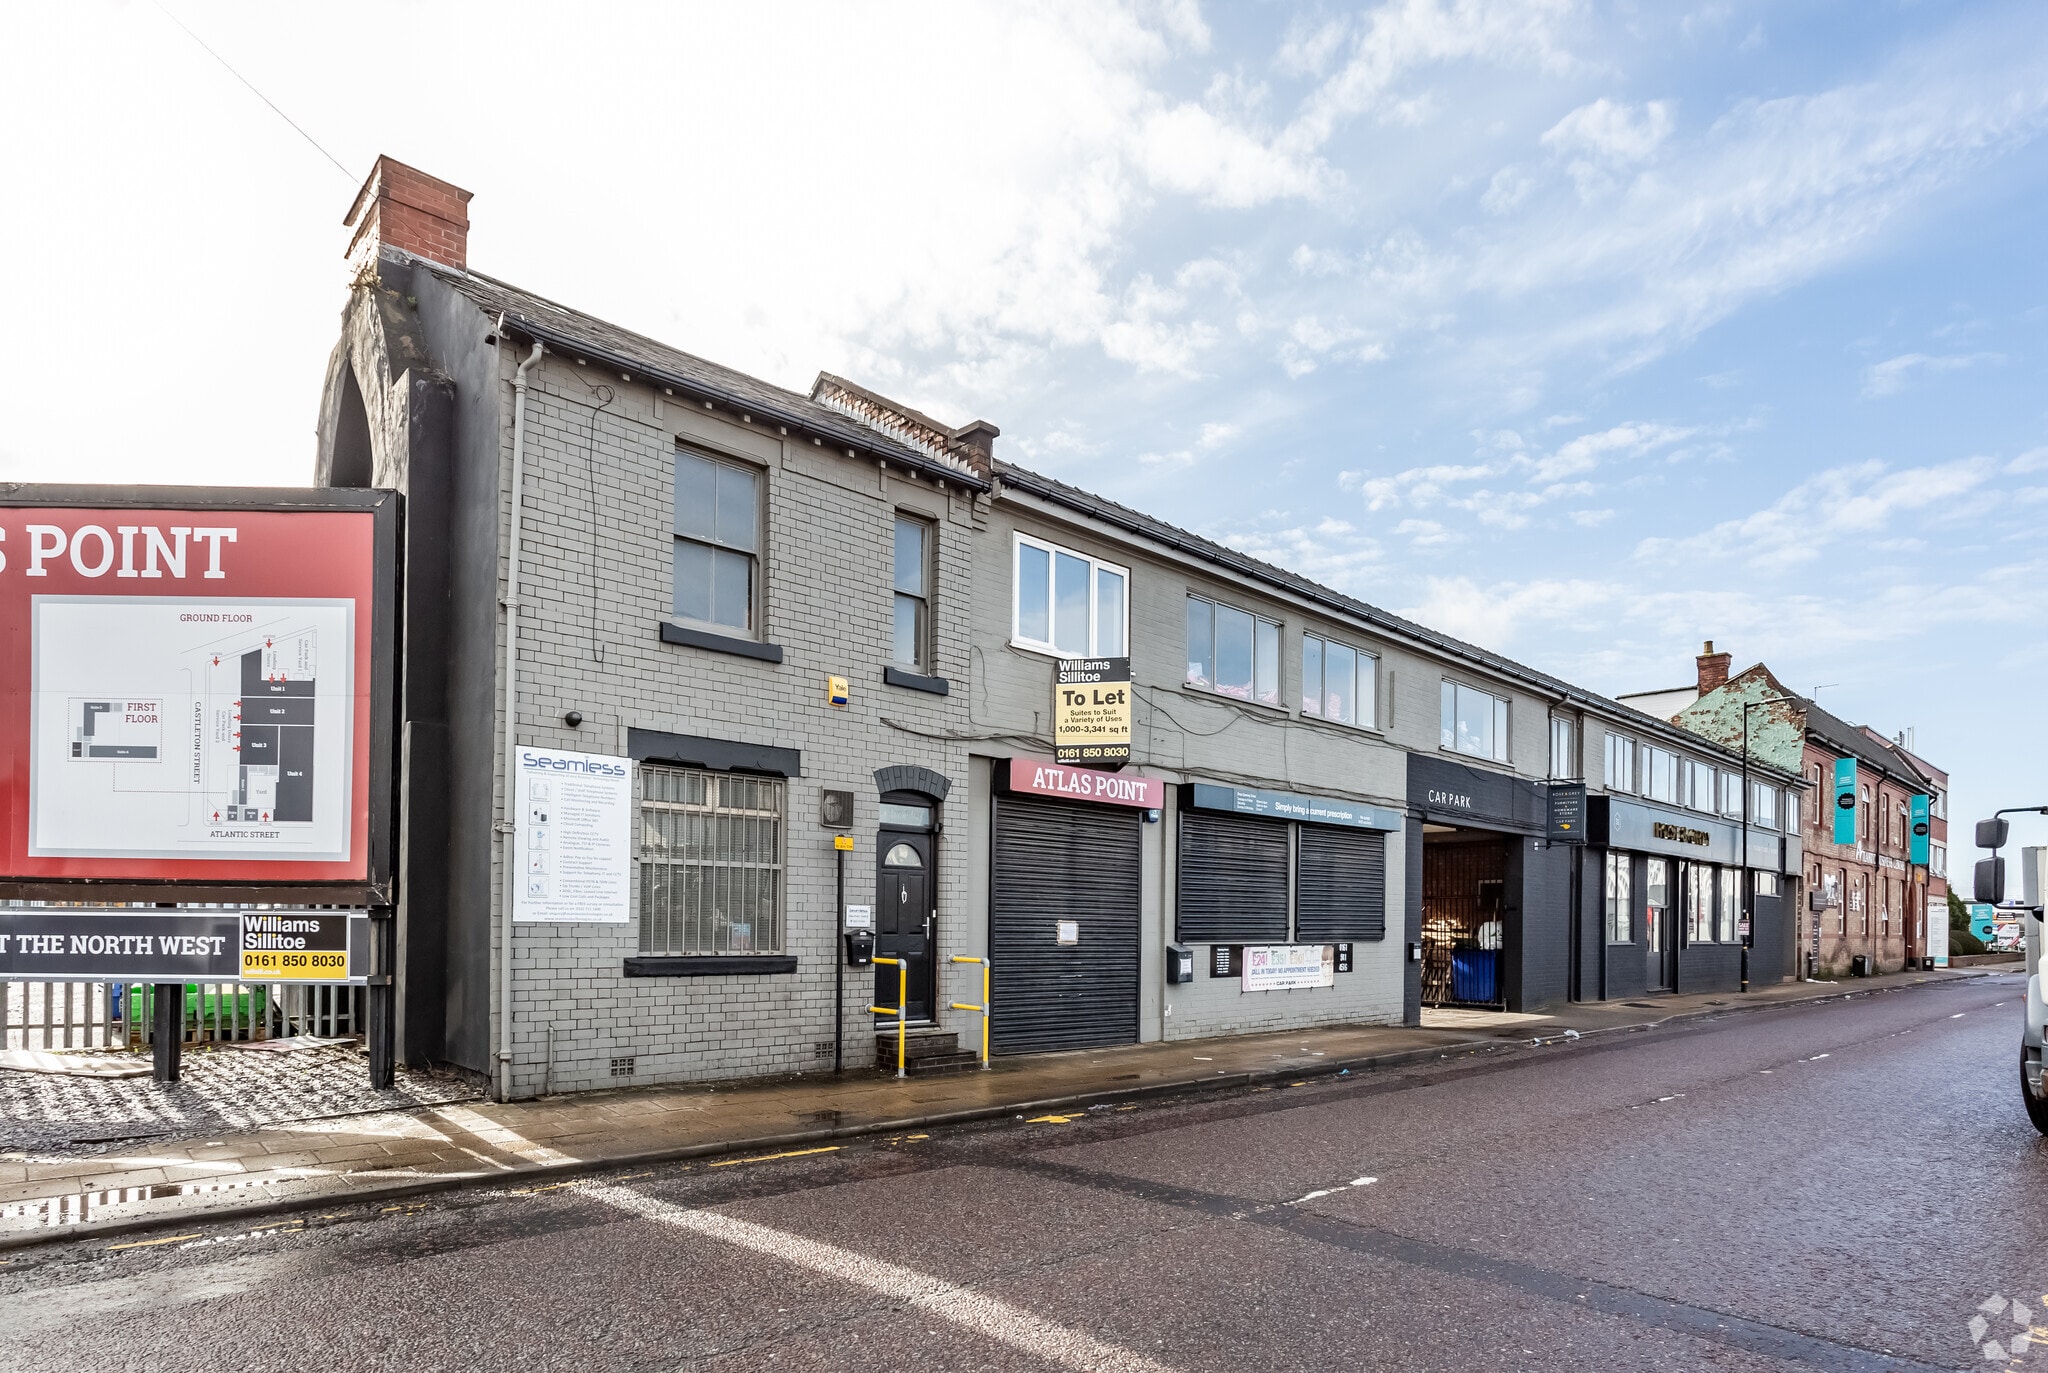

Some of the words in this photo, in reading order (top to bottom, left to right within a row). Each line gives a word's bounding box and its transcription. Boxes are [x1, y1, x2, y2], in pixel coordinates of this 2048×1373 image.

[26, 524, 238, 579] POINT
[180, 613, 220, 622] GROUND
[222, 614, 253, 623] FLOOR
[1059, 660, 1111, 671] Williams
[1059, 671, 1101, 683] Sillitoe
[834, 683, 847, 692] Yale
[1062, 690, 1086, 706] To
[1093, 689, 1125, 705] Let
[127, 702, 157, 712] FIRST
[125, 714, 159, 724] FLOOR
[194, 701, 202, 751] CASTLETON
[1059, 725, 1106, 733] 1,000-3,341
[1057, 748, 1080, 758] 0161
[1083, 748, 1102, 757] 850
[1103, 747, 1129, 757] 8030
[193, 751, 201, 784] STREET
[523, 753, 626, 776] Seamless
[1032, 767, 1092, 795] ATLAS
[1095, 776, 1147, 802] POINT
[1428, 789, 1446, 804] CAR
[1449, 793, 1471, 809] PARK
[1274, 801, 1292, 812] Simply
[1293, 806, 1305, 816] bring
[1310, 808, 1326, 817] current
[1326, 810, 1352, 820] prescription
[250, 831, 280, 839] STREET
[244, 915, 320, 932] Williams
[16, 934, 65, 954] THE
[69, 935, 154, 955] NORTH
[158, 936, 226, 956] WEST
[245, 932, 306, 949] Sillitoe
[244, 955, 277, 967] 0161
[282, 955, 307, 967] 850
[311, 955, 345, 967] 8030
